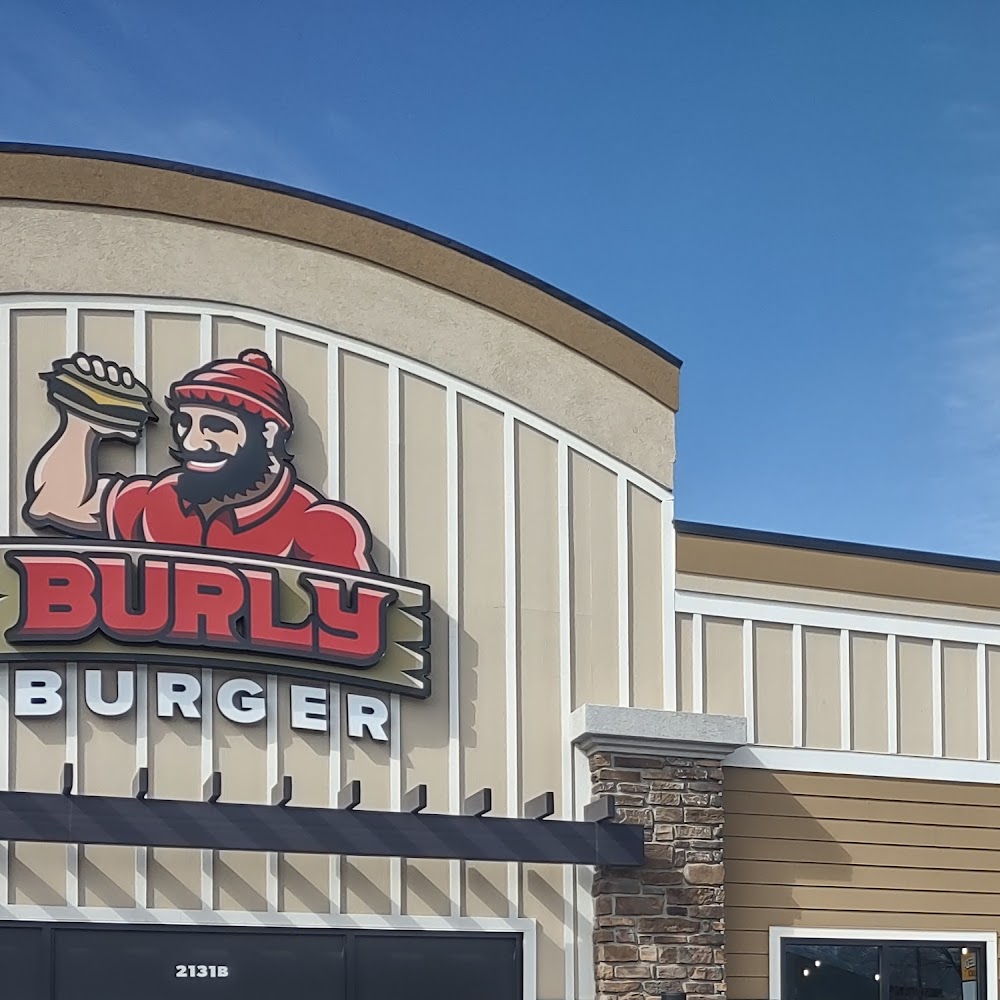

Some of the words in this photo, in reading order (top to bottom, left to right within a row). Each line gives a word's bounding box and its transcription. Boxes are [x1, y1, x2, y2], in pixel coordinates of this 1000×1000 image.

[17, 554, 395, 662] BURLY
[14, 669, 389, 741] BURGER
[175, 965, 229, 978] 2131B
